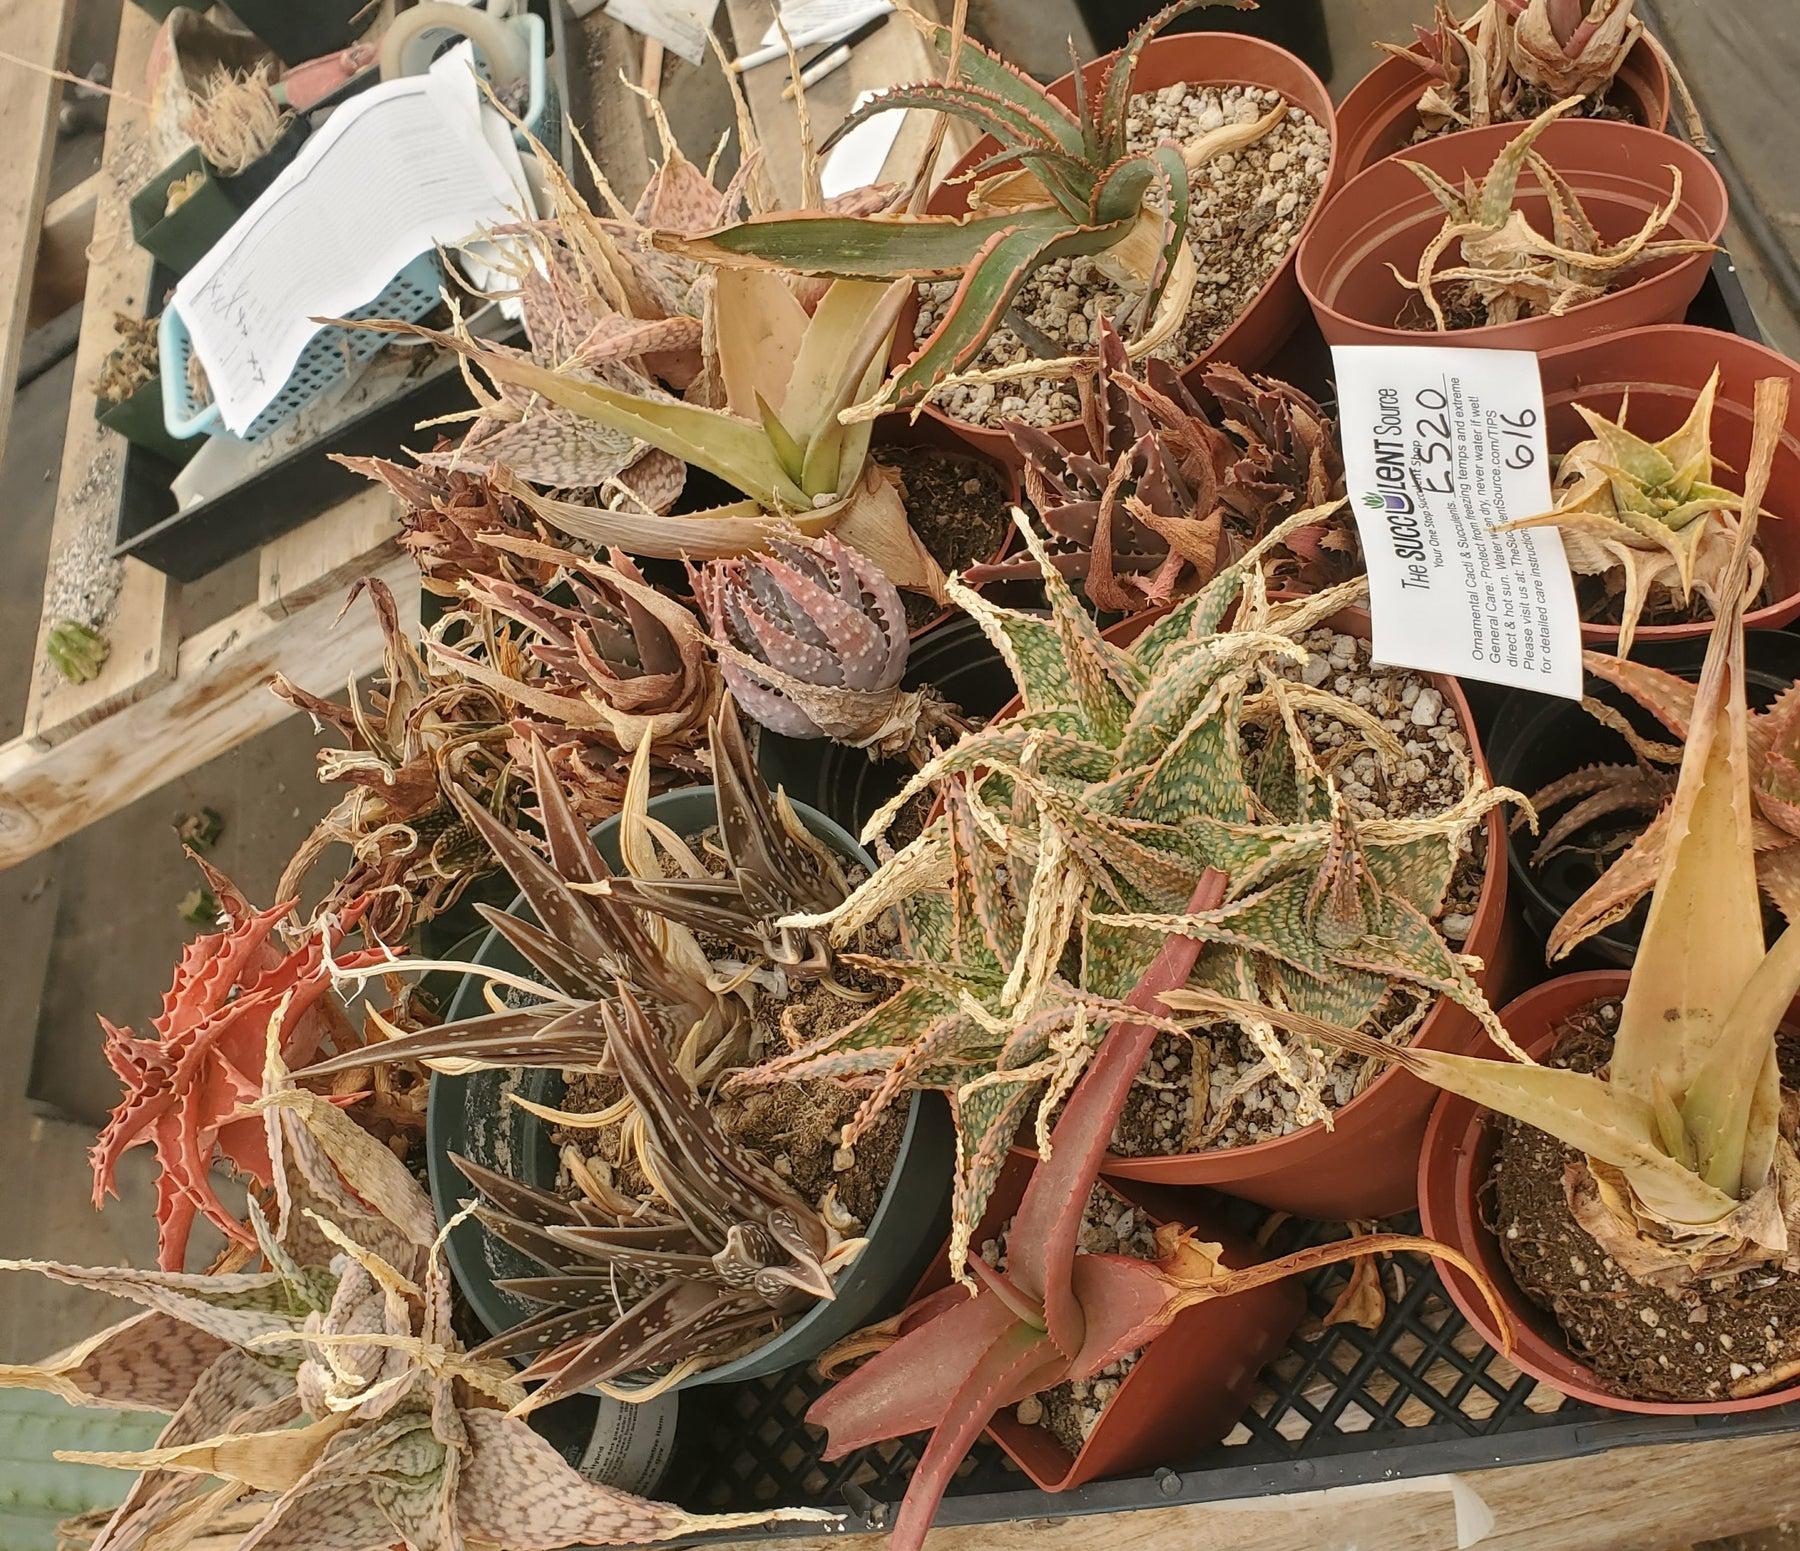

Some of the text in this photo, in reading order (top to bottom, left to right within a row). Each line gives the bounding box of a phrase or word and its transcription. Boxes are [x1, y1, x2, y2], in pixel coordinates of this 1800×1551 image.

[1373, 388, 1402, 436] Source
[1410, 440, 1423, 467] Shop
[1422, 511, 1435, 528] Stop
[1428, 529, 1440, 547] One
[1450, 377, 1501, 664] General Care: Protect from freezing temps and extreme
[1467, 396, 1518, 668] direct & hot sun. Water wen dry, never water if wet!
[1433, 548, 1444, 568] Your
[1486, 409, 1535, 671] Please visit us at: TheSuclentSource.com/TIPS
[1447, 500, 1484, 661] Ornamental Cacti & Succulents.
[1534, 579, 1546, 604] care
[1536, 606, 1551, 654] detailed
[1540, 656, 1552, 674] for
